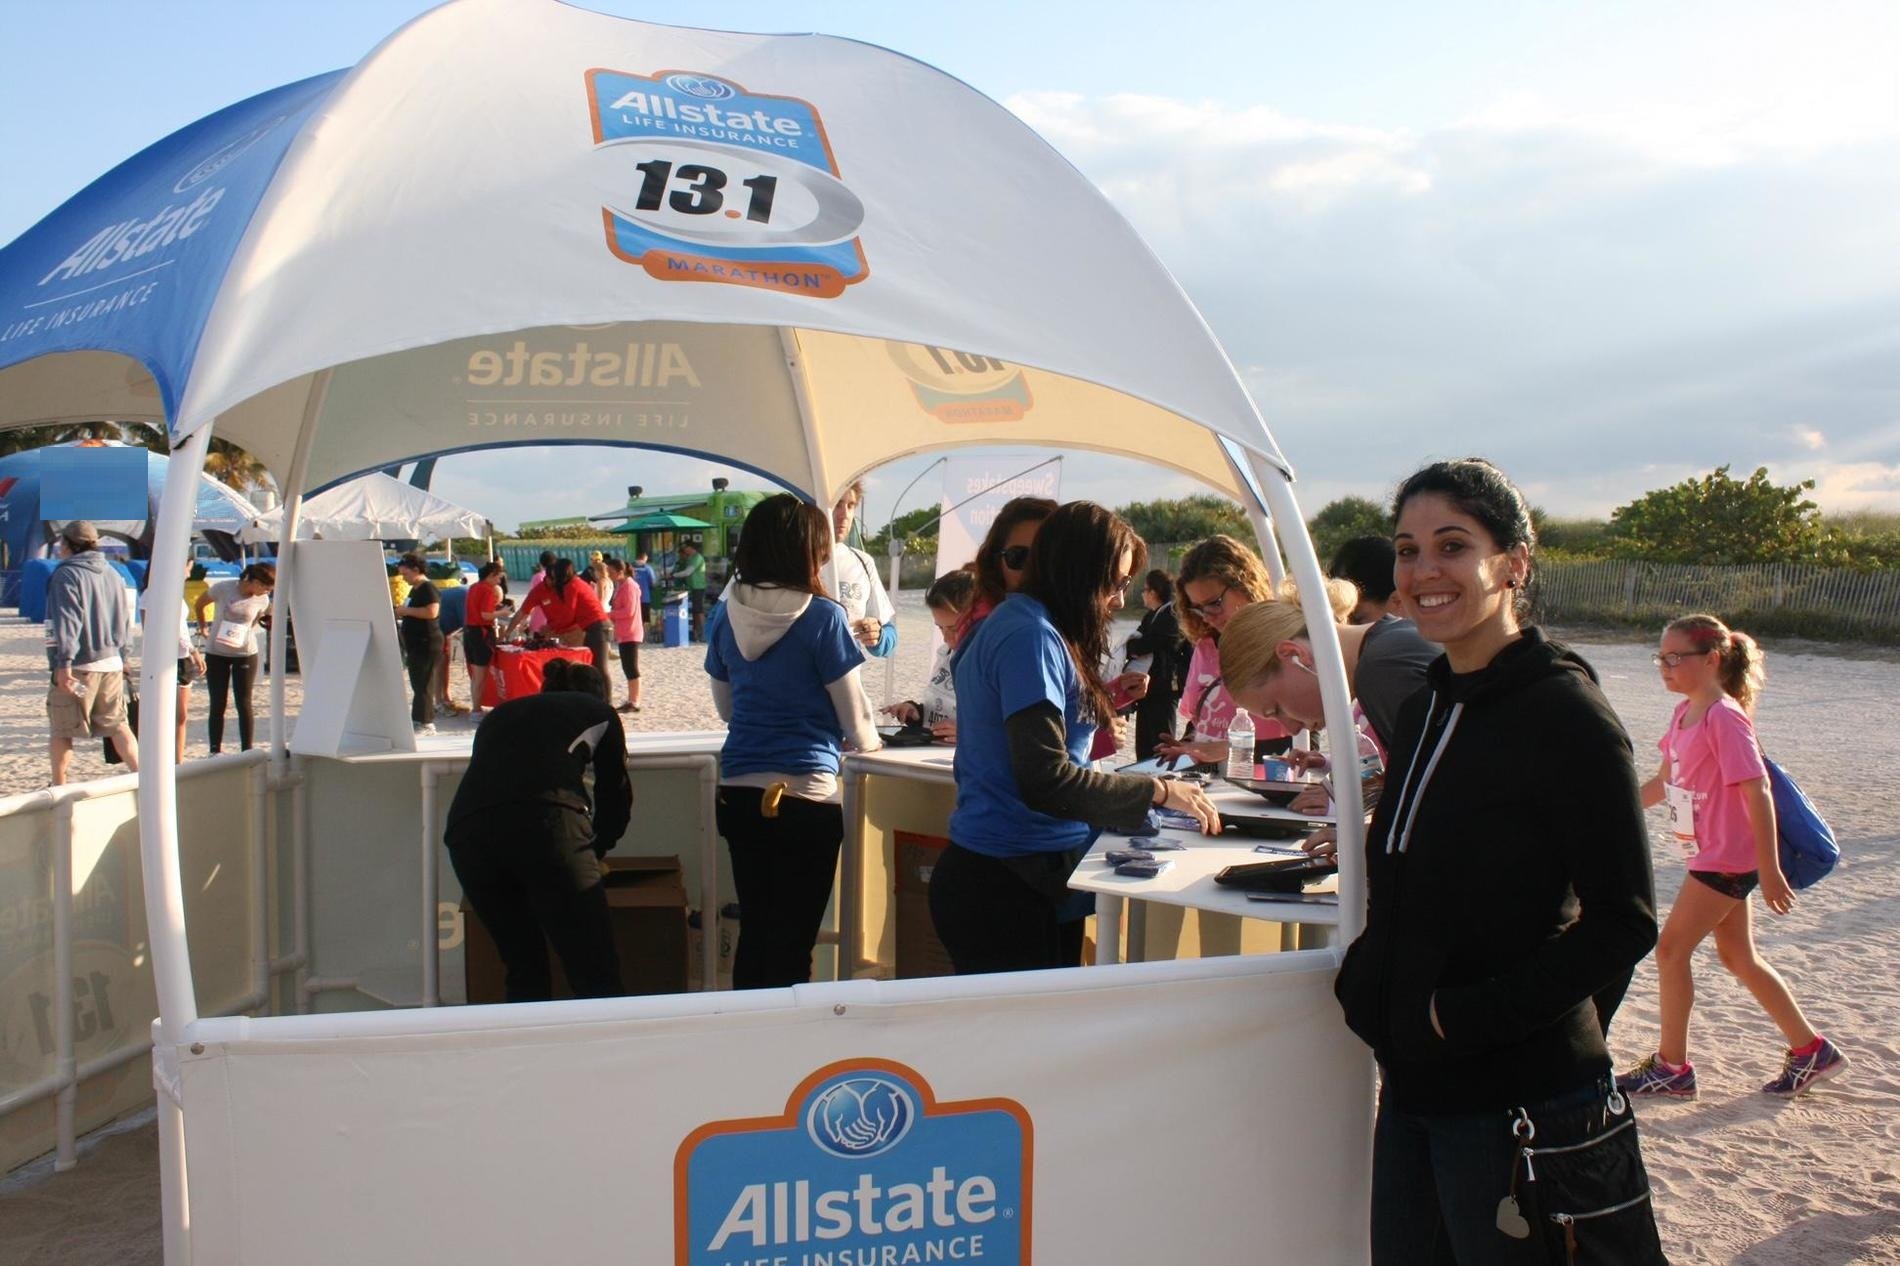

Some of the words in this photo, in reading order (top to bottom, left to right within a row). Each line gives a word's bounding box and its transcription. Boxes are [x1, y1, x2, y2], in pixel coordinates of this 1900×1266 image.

[609, 91, 802, 137] Allstate
[622, 114, 667, 131] LIFE
[674, 124, 799, 149] INSURANCE
[634, 159, 778, 225] 13.1
[37, 187, 226, 287] Allstate
[667, 257, 820, 287] MARATHON
[0, 316, 44, 342] LIFE
[44, 281, 159, 330] INSURANCE
[706, 1166, 996, 1251] Allstate
[803, 1235, 985, 1266] INSURANCE
